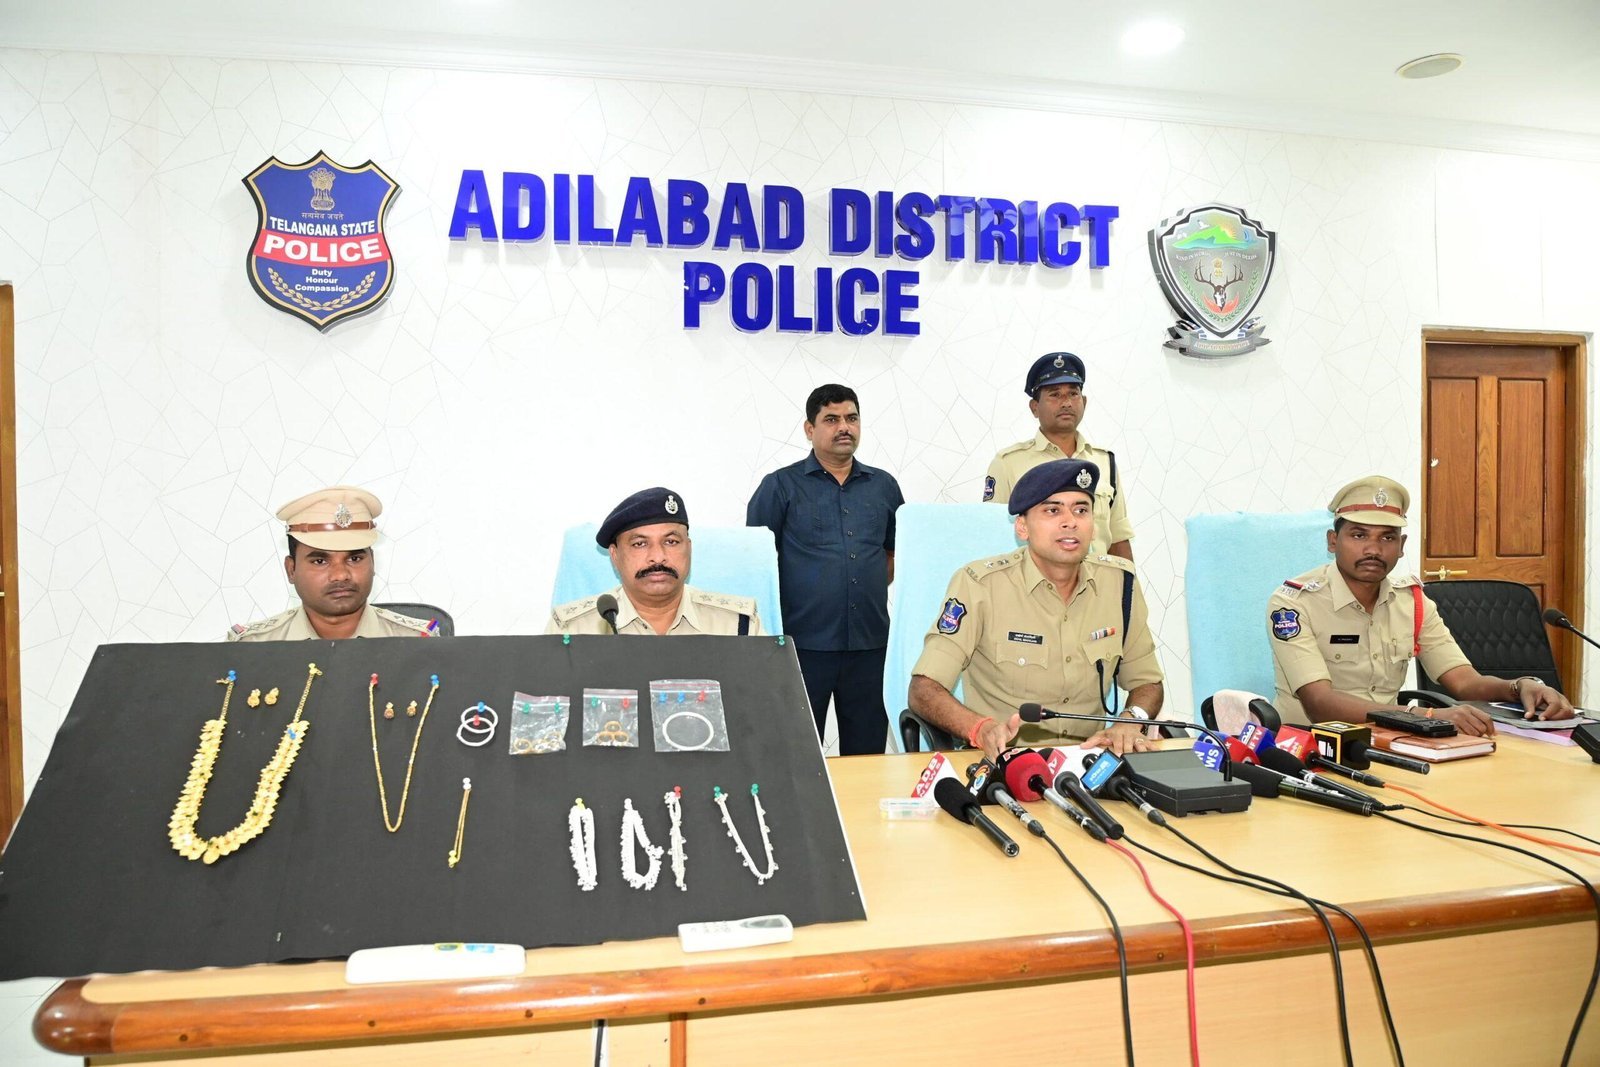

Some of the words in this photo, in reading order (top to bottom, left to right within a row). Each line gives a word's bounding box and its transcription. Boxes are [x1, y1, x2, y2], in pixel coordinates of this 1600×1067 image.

[269, 216, 338, 236] TELANGANA
[340, 220, 376, 236] STATE
[448, 169, 805, 254] ADILABAD
[828, 187, 1120, 270] DISTRICT
[263, 233, 382, 263] POLICE
[305, 276, 339, 284] Honour
[311, 268, 333, 277] Duty
[294, 283, 350, 293] Compassion
[683, 260, 920, 337] POLICE
[916, 758, 938, 796] ADB
